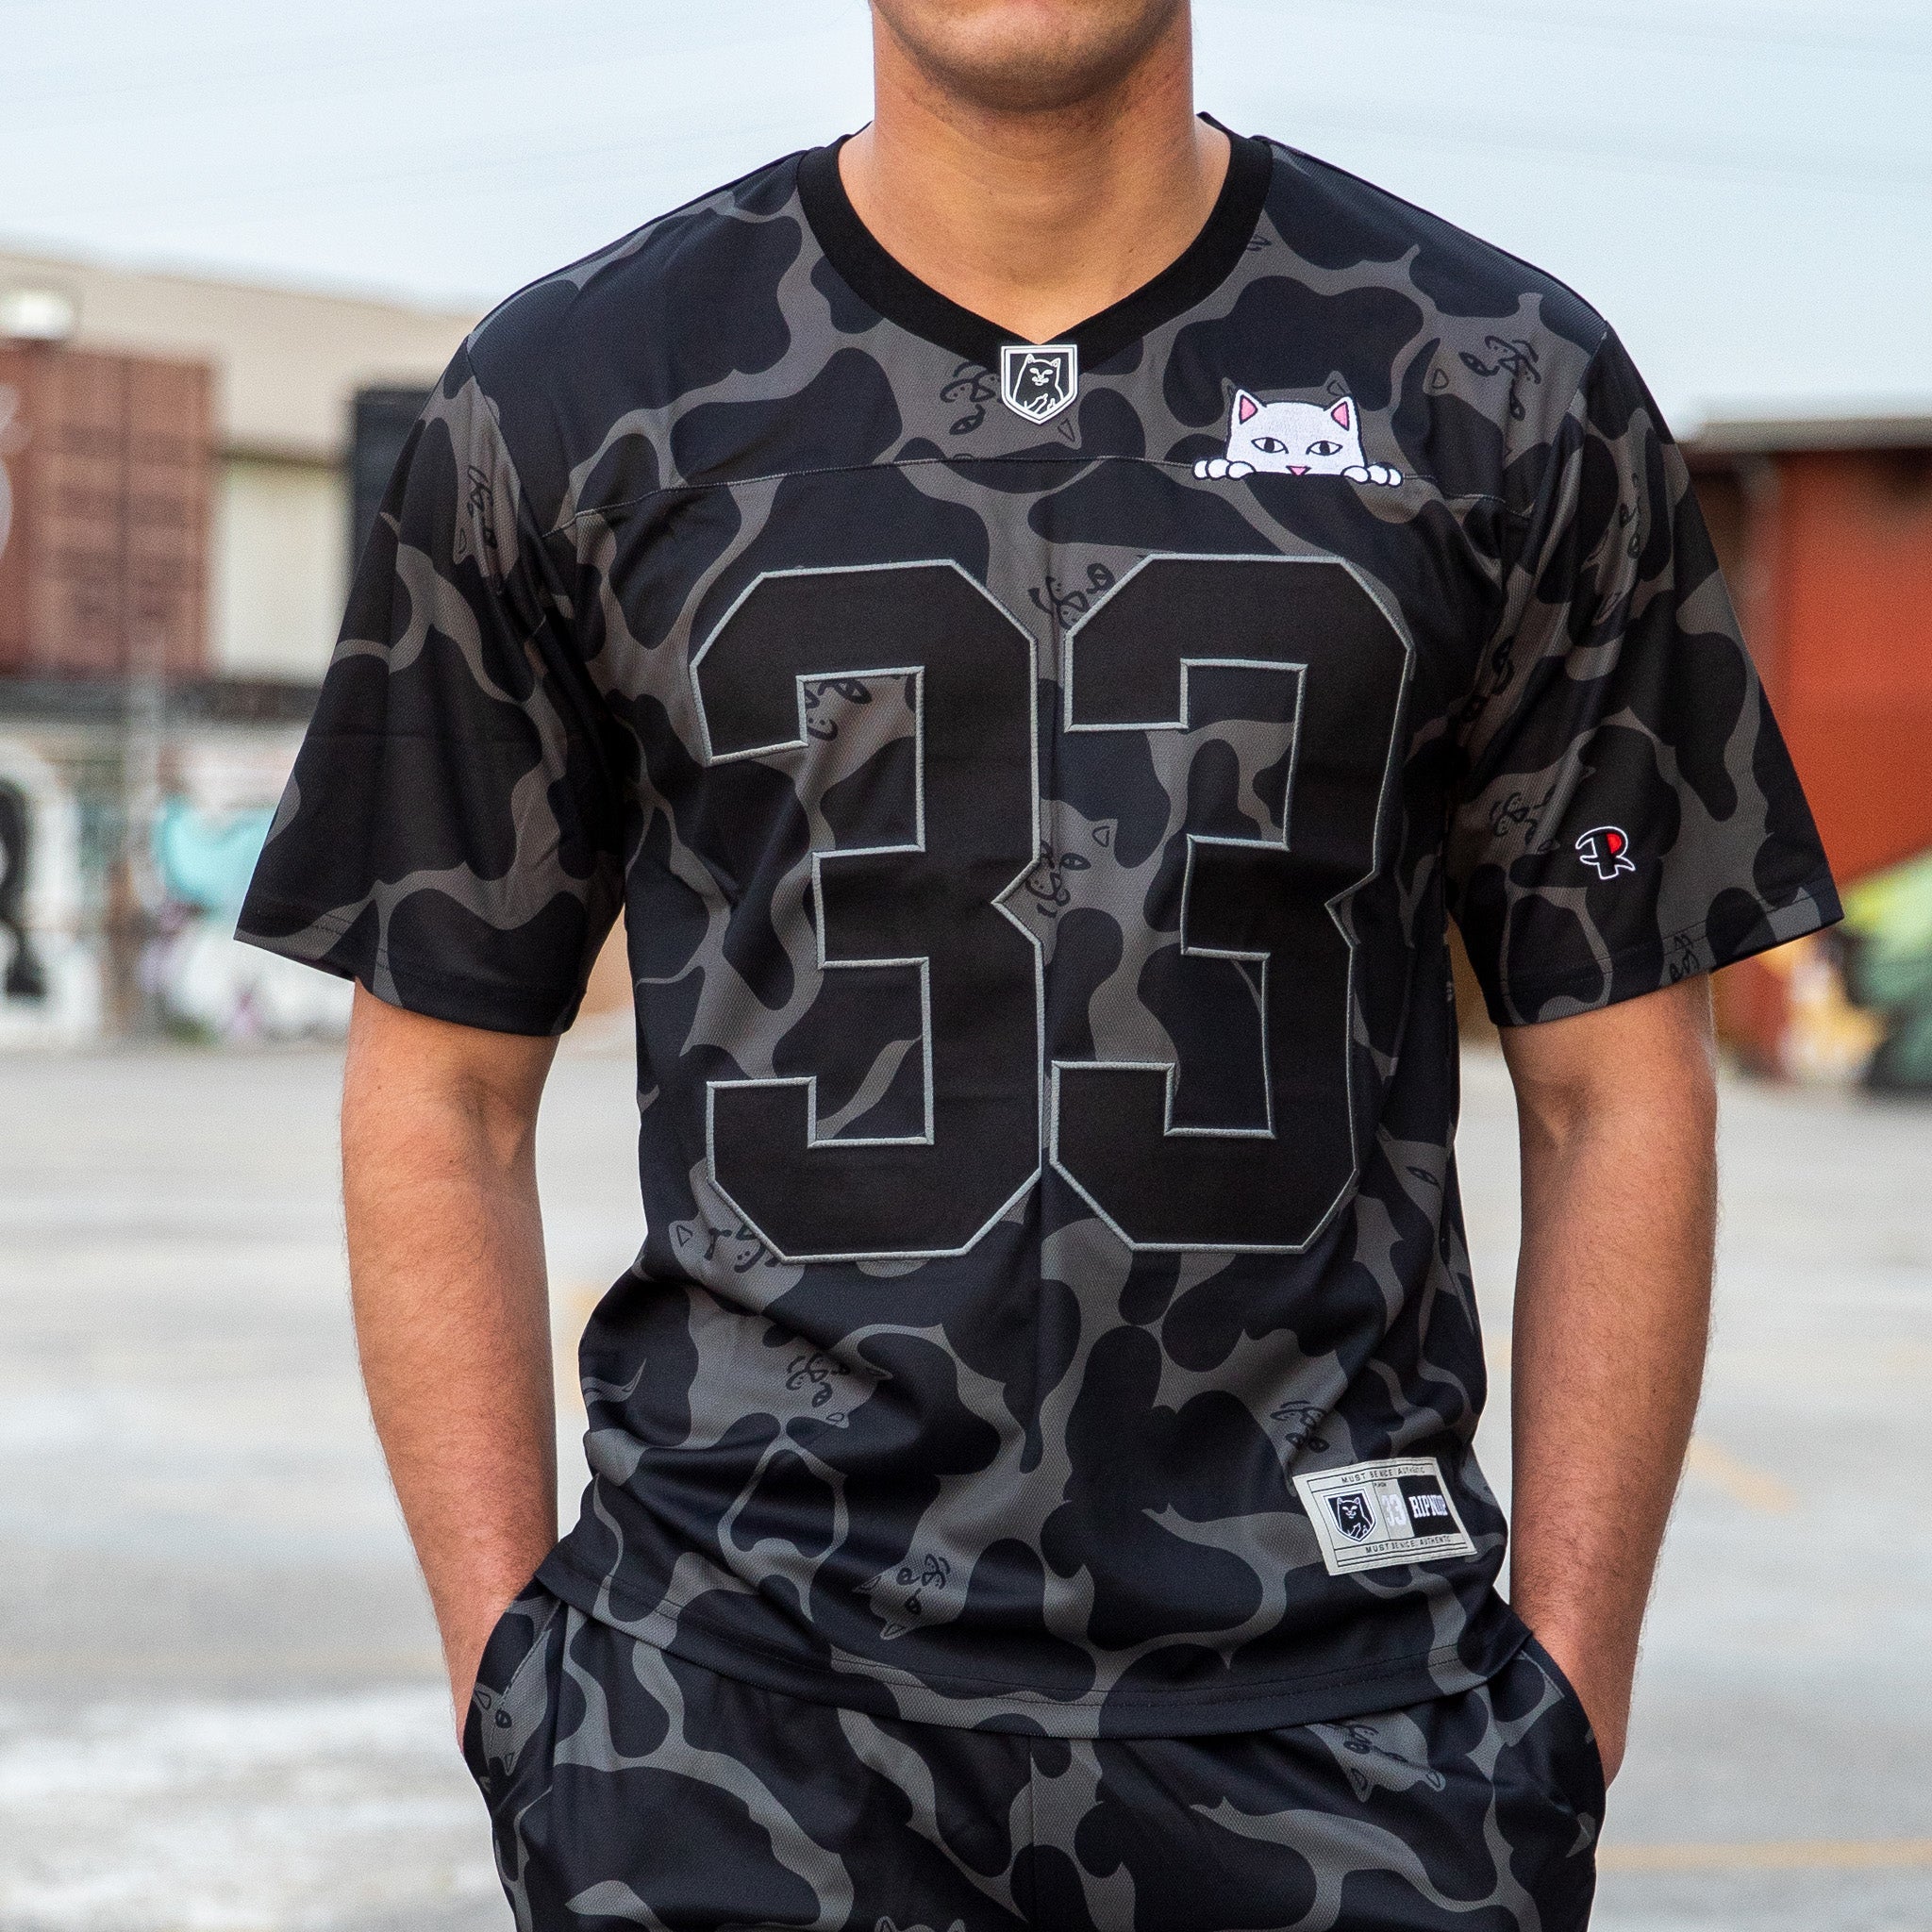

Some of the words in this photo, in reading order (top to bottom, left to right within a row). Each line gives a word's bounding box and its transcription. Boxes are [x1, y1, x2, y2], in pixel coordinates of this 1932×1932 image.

[690, 554, 1414, 1265] 33
[1341, 1473, 1366, 1484] MUST
[1379, 1469, 1393, 1477] NCE
[1381, 1493, 1407, 1526] 33
[1408, 1494, 1448, 1519] RIPNP
[1365, 1542, 1389, 1553] MUST
[1400, 1540, 1415, 1549] NCE
[1420, 1535, 1451, 1546] AUTHENTC
